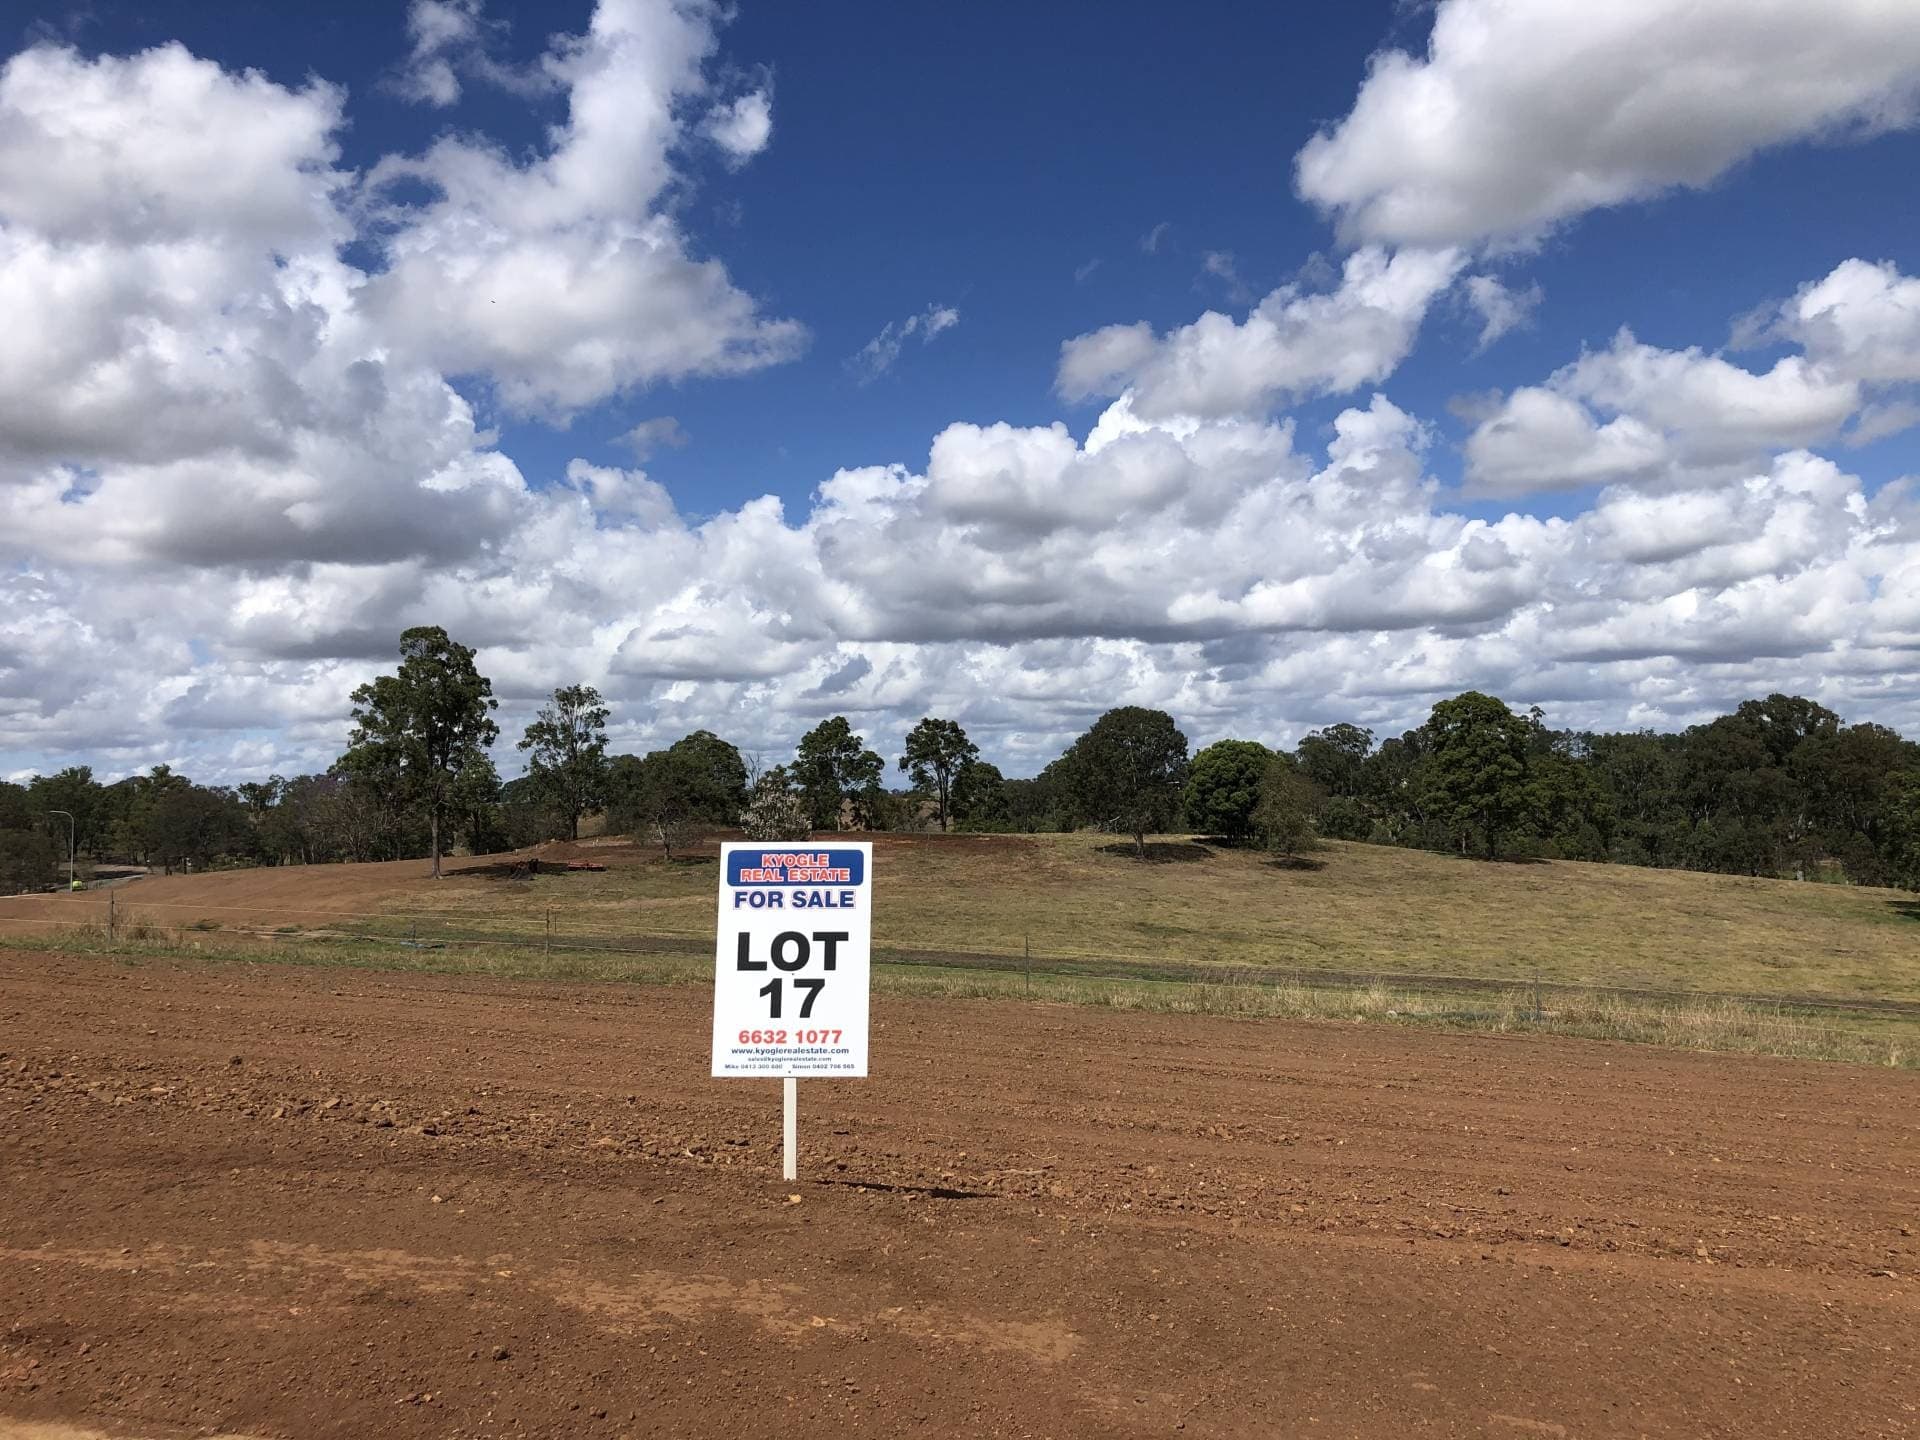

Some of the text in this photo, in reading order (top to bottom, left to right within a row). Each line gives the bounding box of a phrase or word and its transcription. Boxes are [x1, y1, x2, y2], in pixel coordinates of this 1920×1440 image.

[761, 853, 830, 867] KYOGLE
[740, 868, 850, 882] REAL ESTATE
[734, 890, 855, 908] FOR SALE
[736, 931, 849, 972] LOT
[759, 977, 826, 1019] 17
[738, 1029, 843, 1044] 6632 1077
[731, 1047, 849, 1056] www.kyoglerealestate.com
